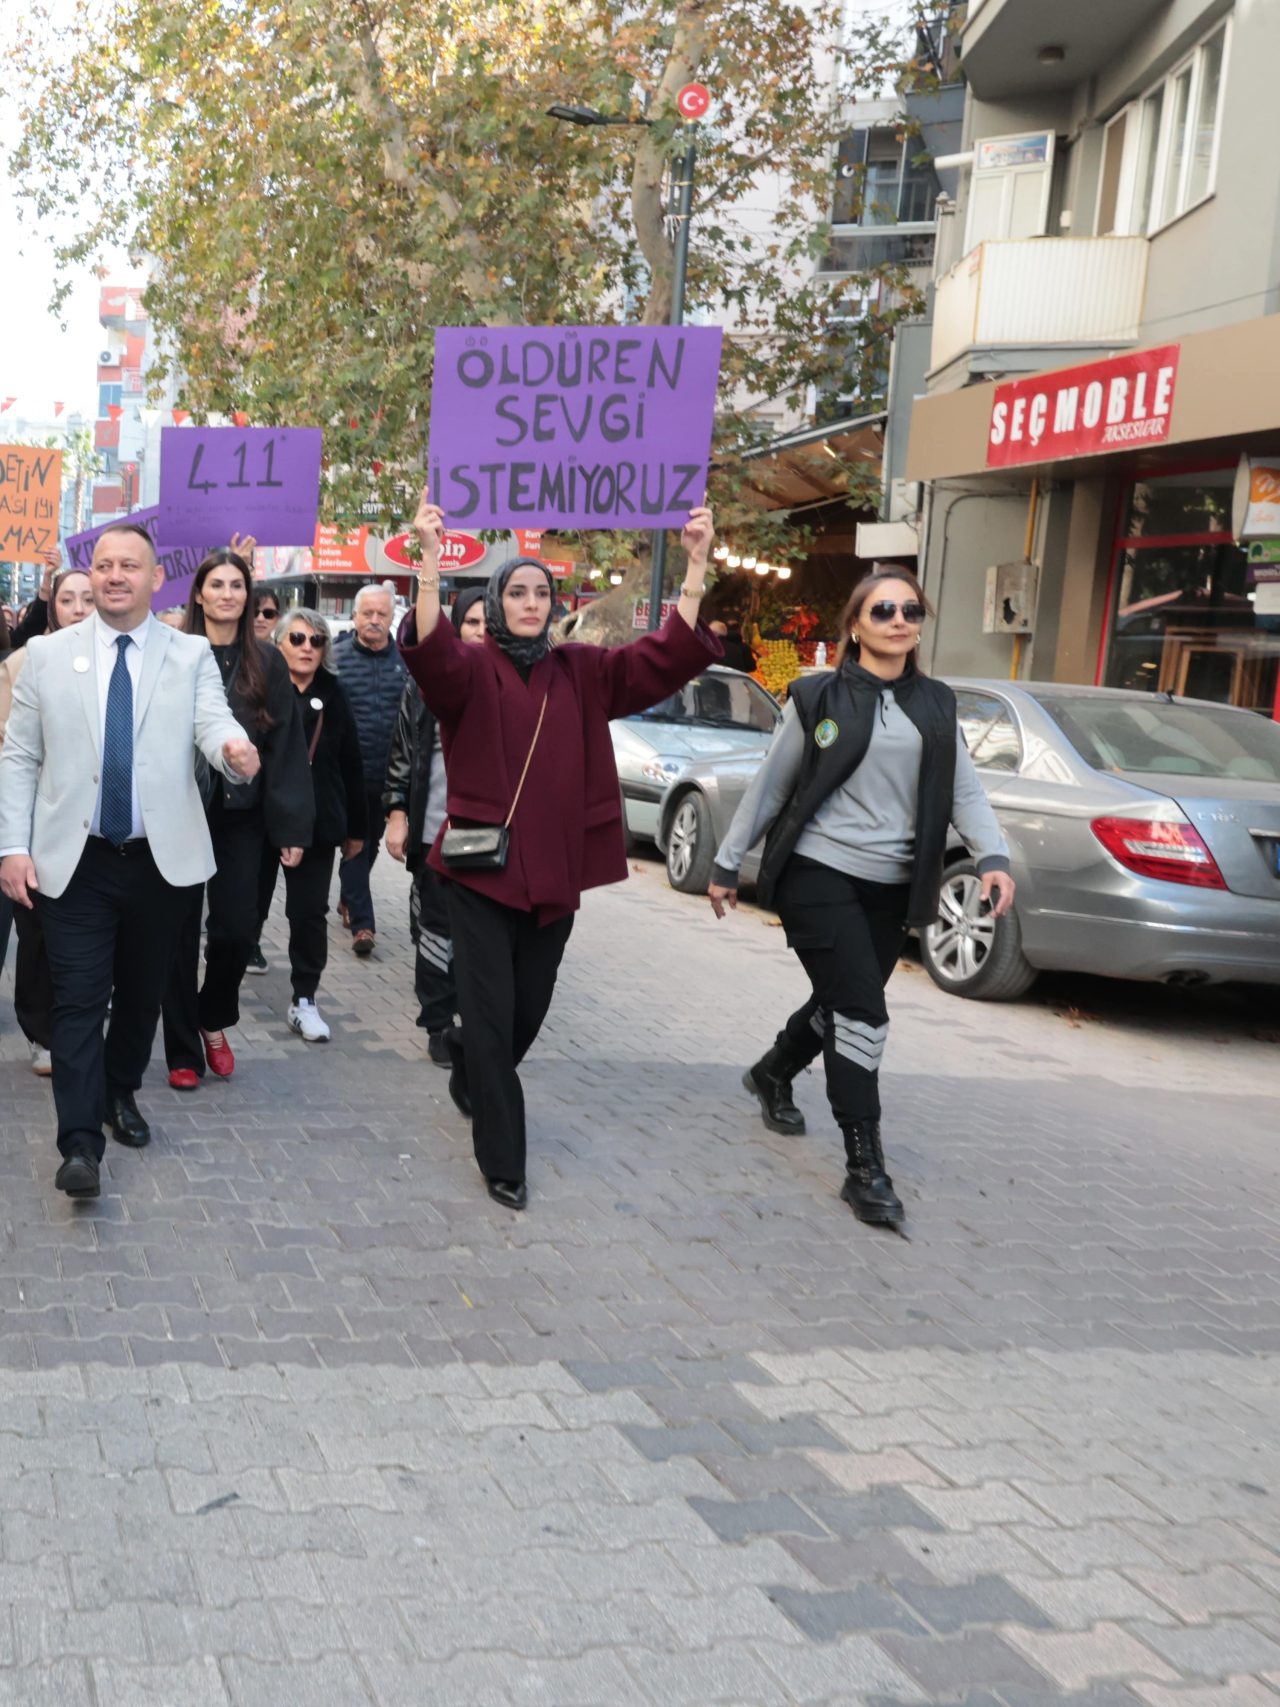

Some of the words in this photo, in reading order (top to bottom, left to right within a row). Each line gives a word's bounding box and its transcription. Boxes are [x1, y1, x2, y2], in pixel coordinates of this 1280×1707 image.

[457, 331, 685, 390] ÖLDÜREN
[495, 392, 646, 446] SEVGİ
[432, 455, 701, 518] İSTEMİYORUZ
